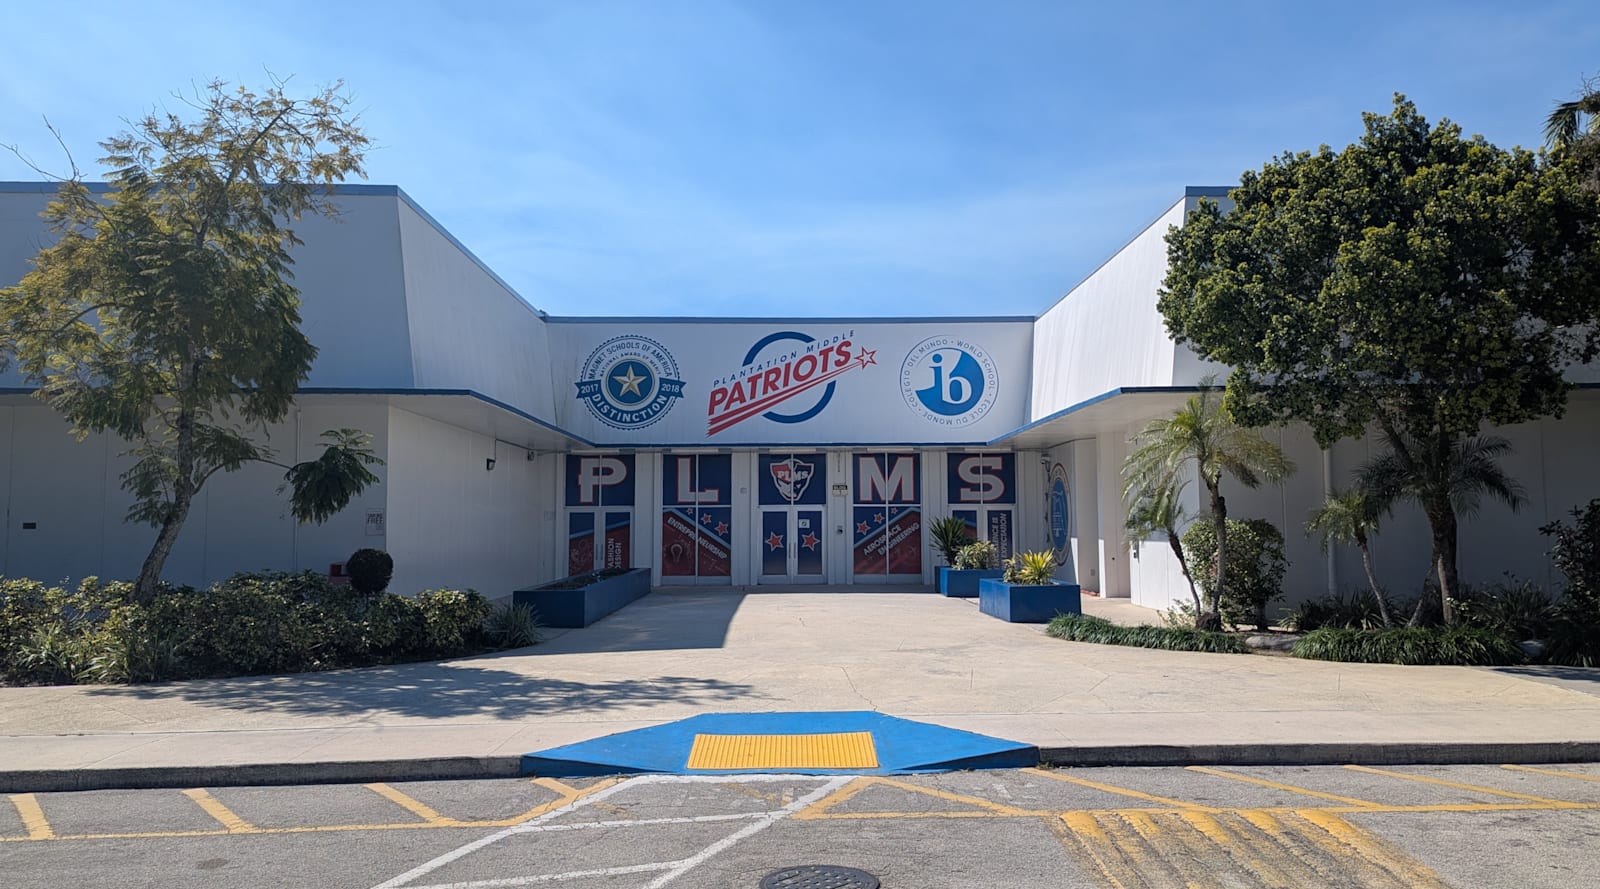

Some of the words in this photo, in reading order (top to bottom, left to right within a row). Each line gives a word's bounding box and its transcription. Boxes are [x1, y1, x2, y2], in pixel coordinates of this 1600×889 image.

[588, 352, 607, 379] MAGNET
[607, 342, 640, 354] SCHOOLS
[652, 350, 672, 376] AMERICA
[713, 351, 797, 388] PLANTATION
[806, 329, 855, 353] MIDDLE
[919, 339, 948, 353] MUNDO
[907, 354, 919, 368] DEL
[957, 341, 983, 357] WORLD
[982, 358, 996, 389] SCHOOL
[581, 383, 599, 394] 2017
[661, 383, 680, 393] 2018
[708, 340, 852, 416] PATRIOTS
[903, 370, 918, 408] COLEGIO
[592, 393, 668, 422] DISTINCTION
[922, 411, 953, 425] MONDE
[956, 416, 968, 425] DU
[578, 457, 628, 503] P
[677, 457, 719, 503] L
[859, 456, 914, 501] M
[957, 456, 1005, 501] S
[777, 470, 809, 481] PLMS
[607, 538, 615, 568] ASHION
[863, 524, 902, 556] AEROSPACE
